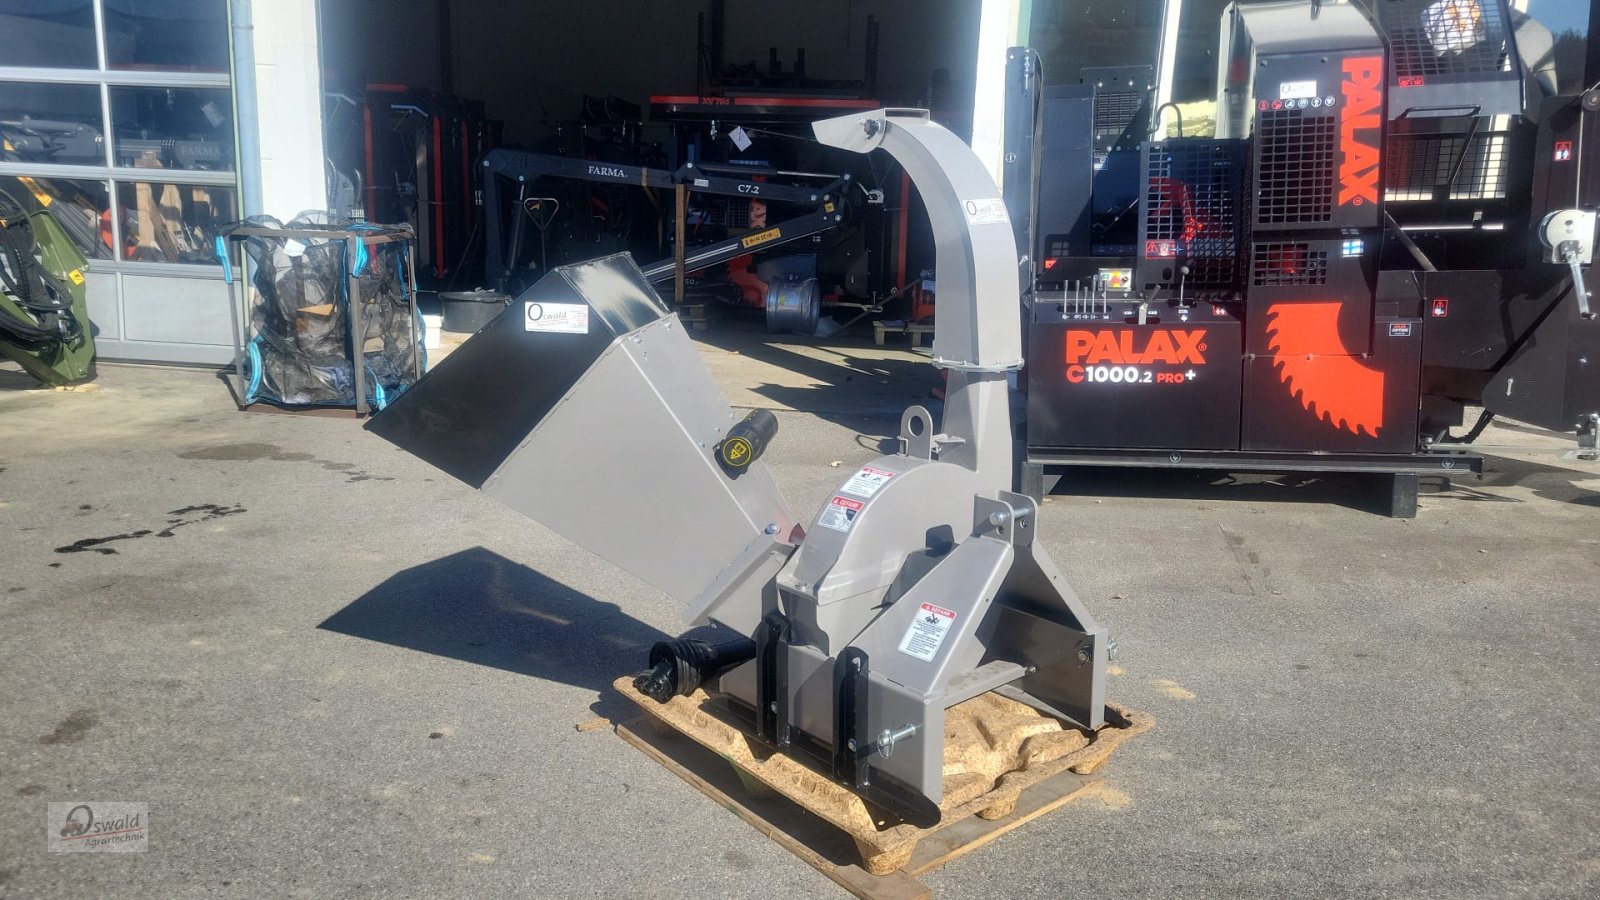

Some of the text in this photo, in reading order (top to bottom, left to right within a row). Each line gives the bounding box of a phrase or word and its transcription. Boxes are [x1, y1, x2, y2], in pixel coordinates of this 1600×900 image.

[1338, 56, 1381, 207] PALAX
[588, 166, 627, 178] FARMA
[737, 184, 760, 194] C7.2
[1066, 329, 1207, 364] PALAX
[1066, 365, 1152, 383] C1000.2
